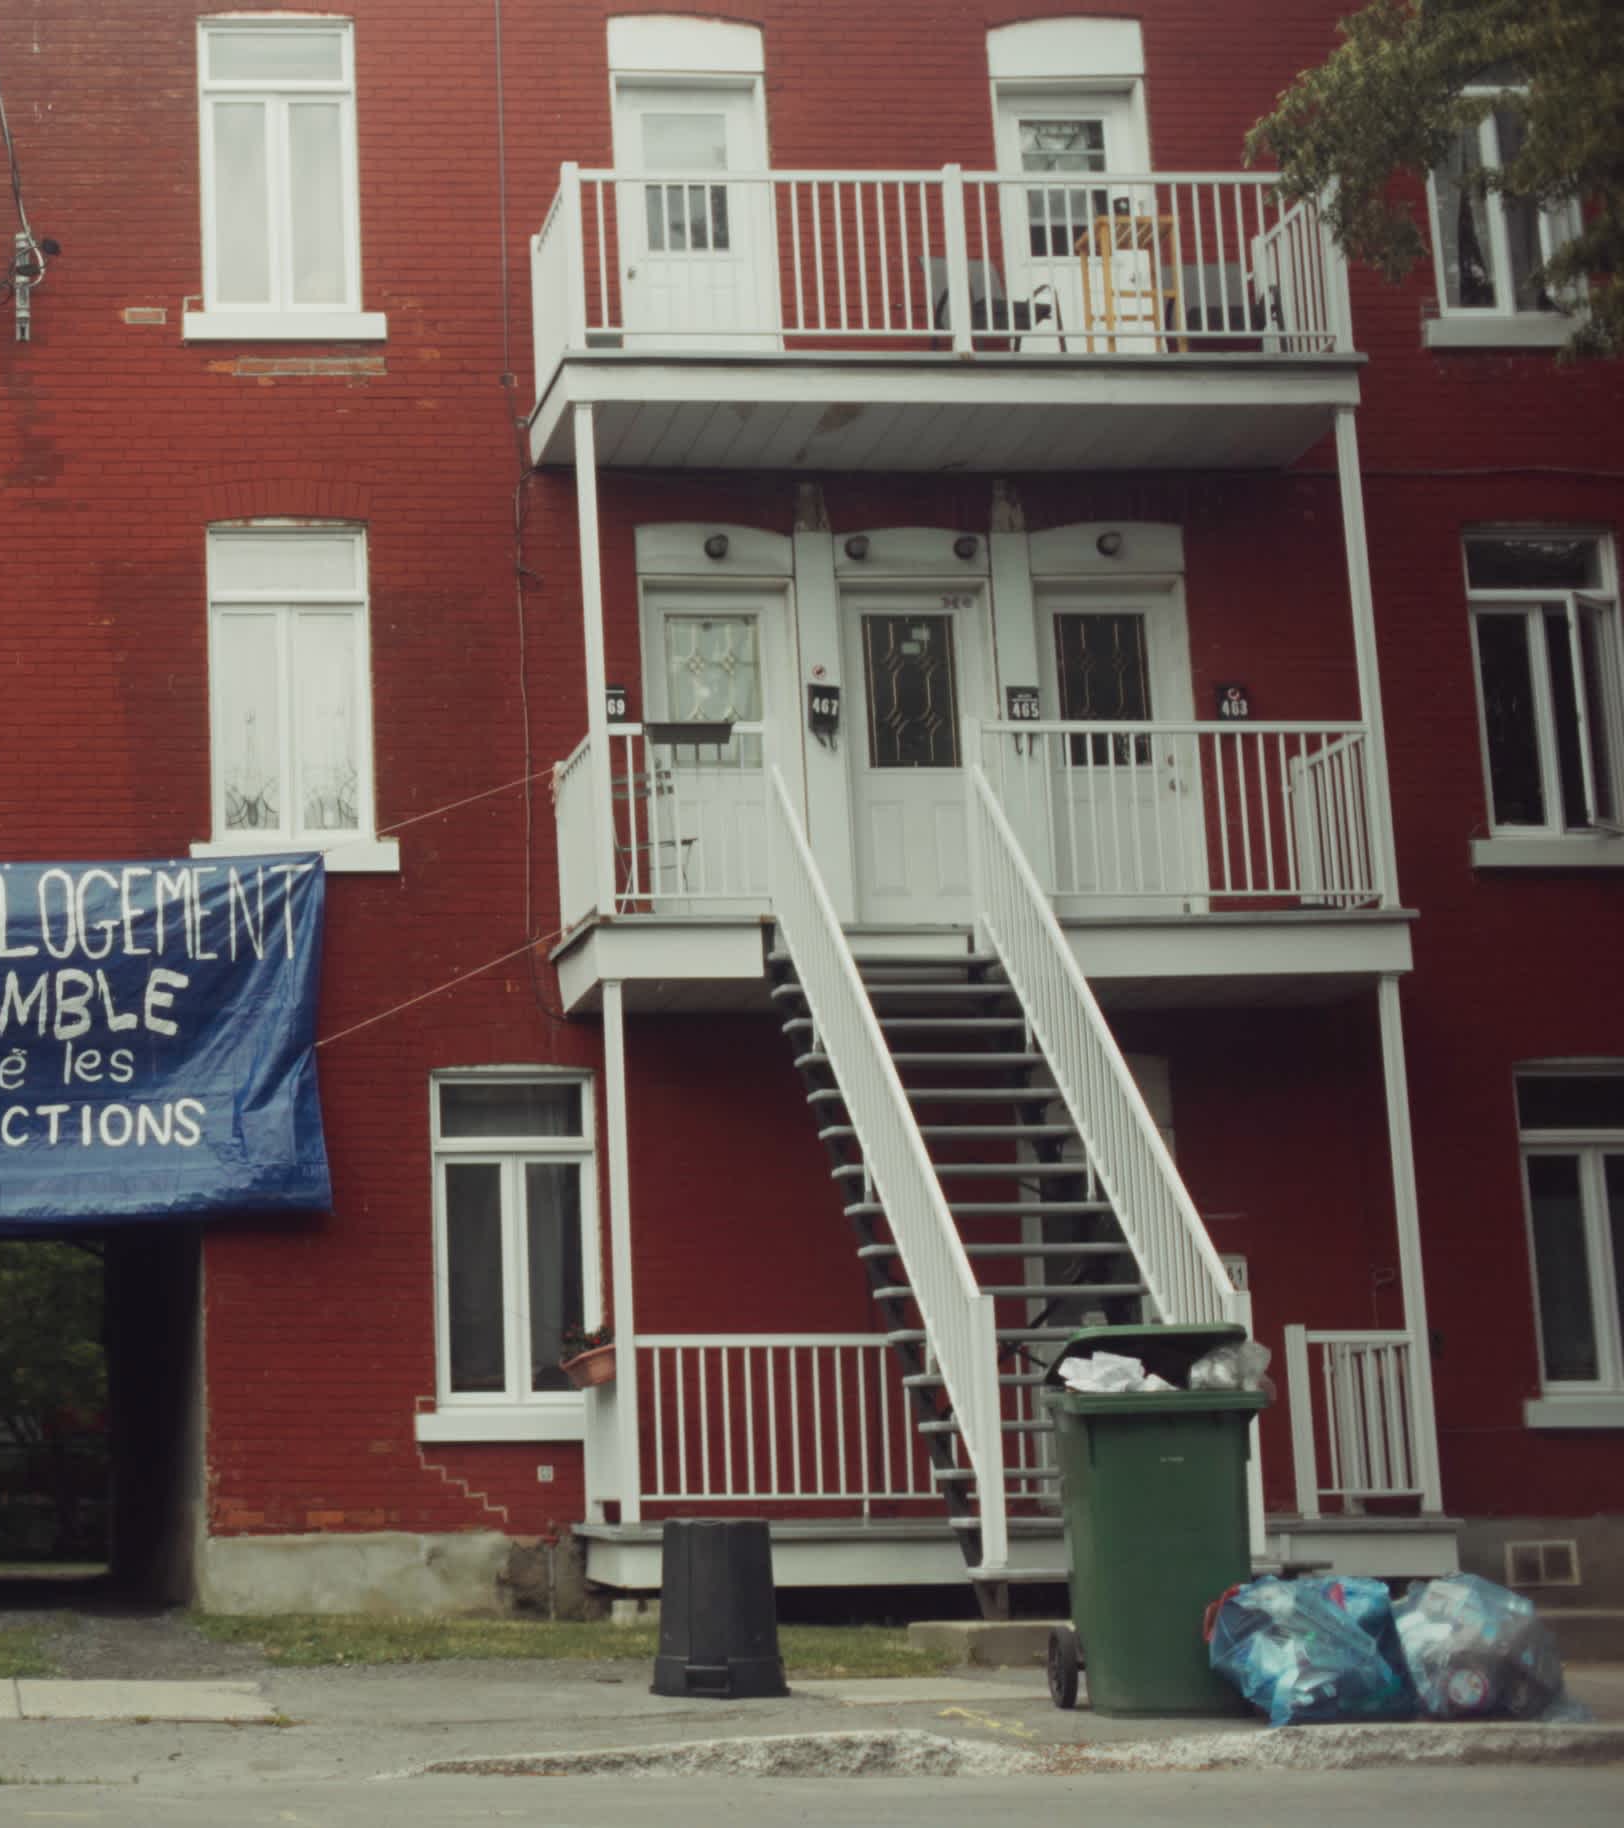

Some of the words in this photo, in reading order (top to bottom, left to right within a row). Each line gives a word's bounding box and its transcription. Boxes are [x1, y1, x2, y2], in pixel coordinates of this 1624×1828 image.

[607, 699, 625, 715] 69
[813, 697, 838, 716] 467
[1013, 702, 1040, 718] 465
[63, 1040, 136, 1086] les
